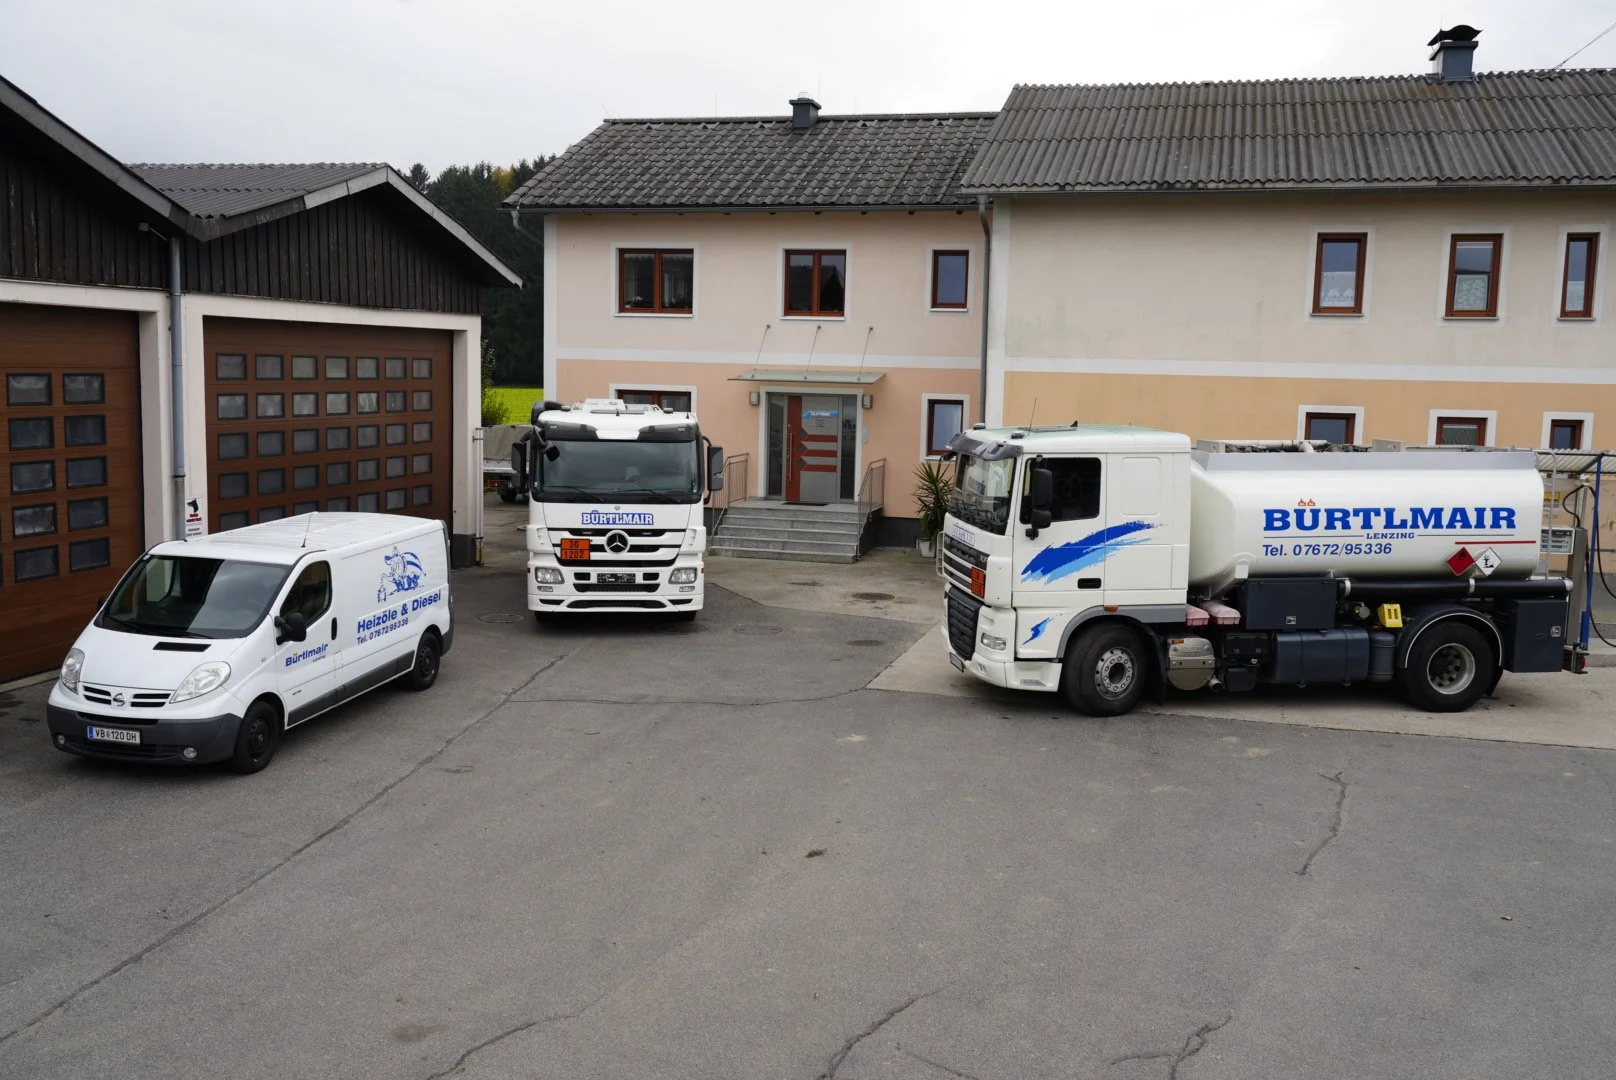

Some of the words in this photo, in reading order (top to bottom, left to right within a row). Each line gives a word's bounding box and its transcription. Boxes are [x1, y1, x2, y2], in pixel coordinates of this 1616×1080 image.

[582, 510, 654, 525] BÜRTLMAIR
[1263, 498, 1517, 531] BÜRTLMAIR
[1366, 532, 1415, 540] LENZING
[569, 540, 579, 548] 30
[1262, 544, 1288, 556] Tel.
[1293, 542, 1393, 556] 07672/95336
[564, 551, 585, 559] 1202
[357, 610, 398, 634] Heizöle
[401, 603, 409, 616] &
[412, 589, 442, 611] Diesel
[356, 635, 368, 646] Tel.
[285, 643, 329, 667] Bürtlmair
[110, 730, 125, 740] 120
